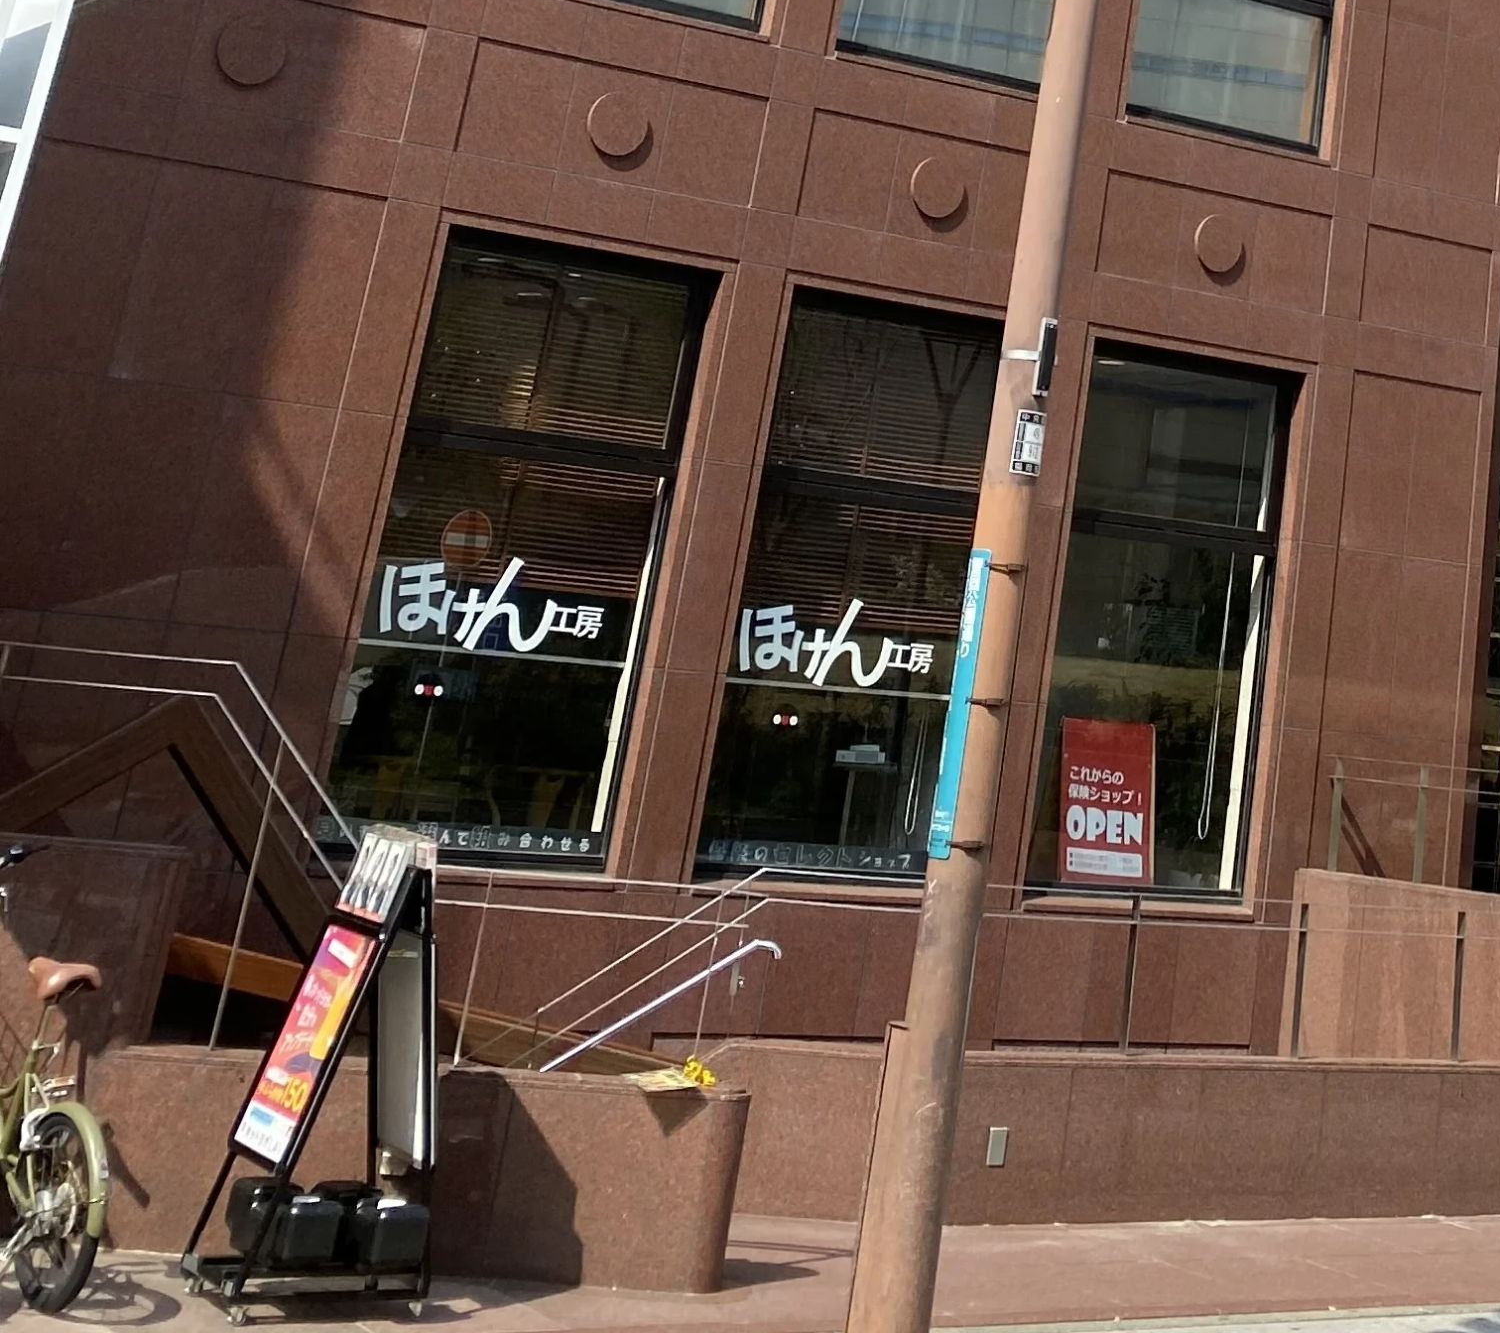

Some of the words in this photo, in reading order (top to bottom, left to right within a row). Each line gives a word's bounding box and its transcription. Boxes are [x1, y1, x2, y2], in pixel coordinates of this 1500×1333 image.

[1069, 765, 1124, 785] これからの
[1066, 804, 1144, 846] OPEN
